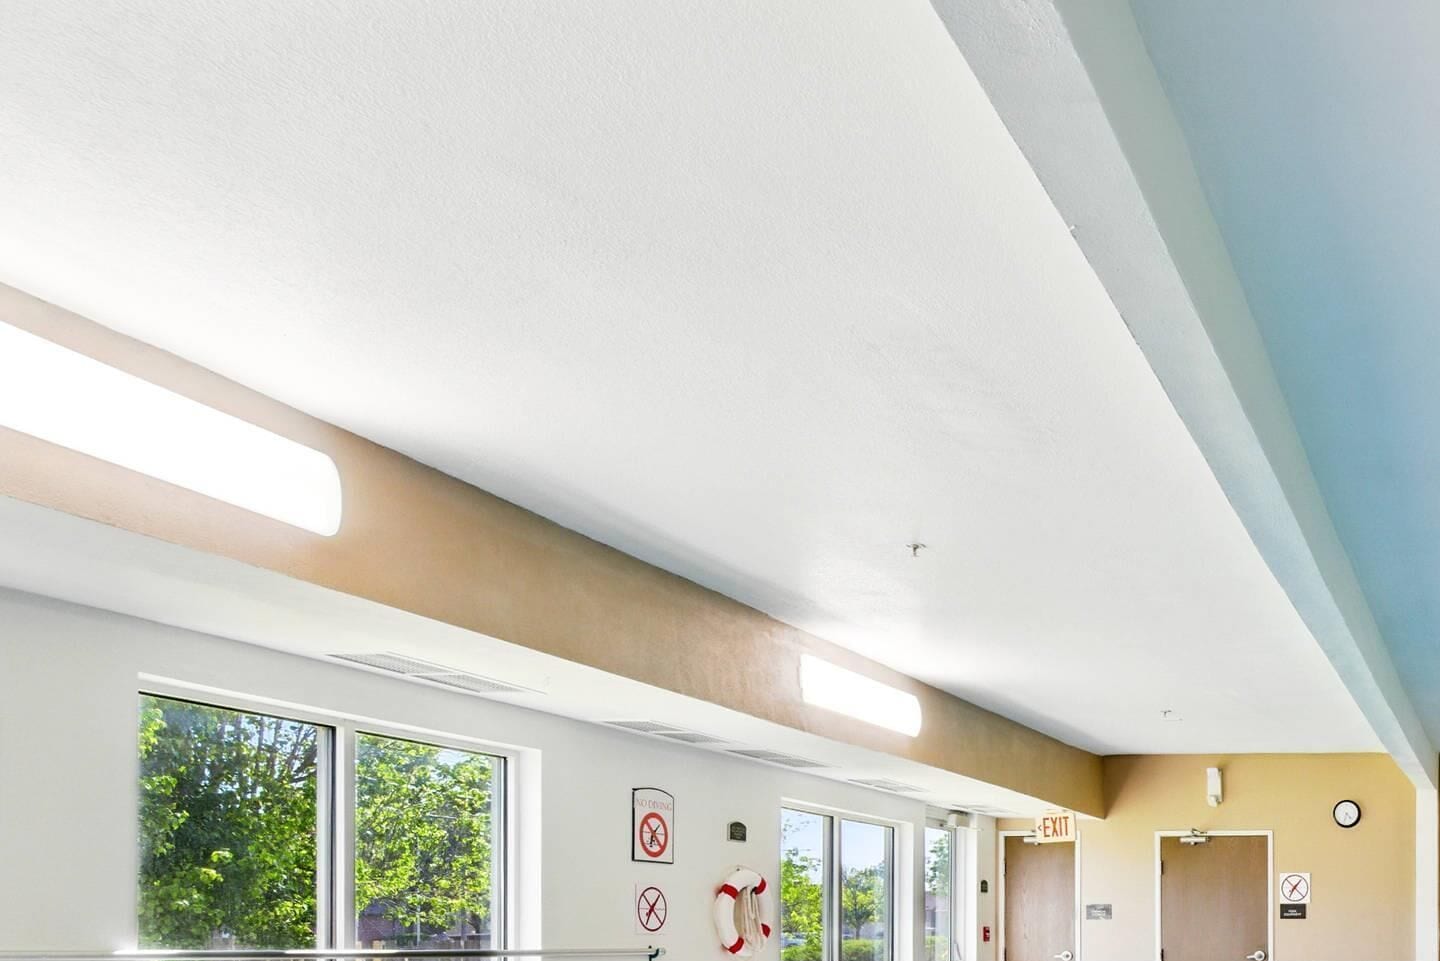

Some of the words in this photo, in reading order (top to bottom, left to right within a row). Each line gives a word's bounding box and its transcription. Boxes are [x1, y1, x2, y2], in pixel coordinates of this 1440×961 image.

[636, 799, 648, 808] NO
[648, 799, 672, 812] DIVING
[1043, 816, 1070, 838] EXIT
